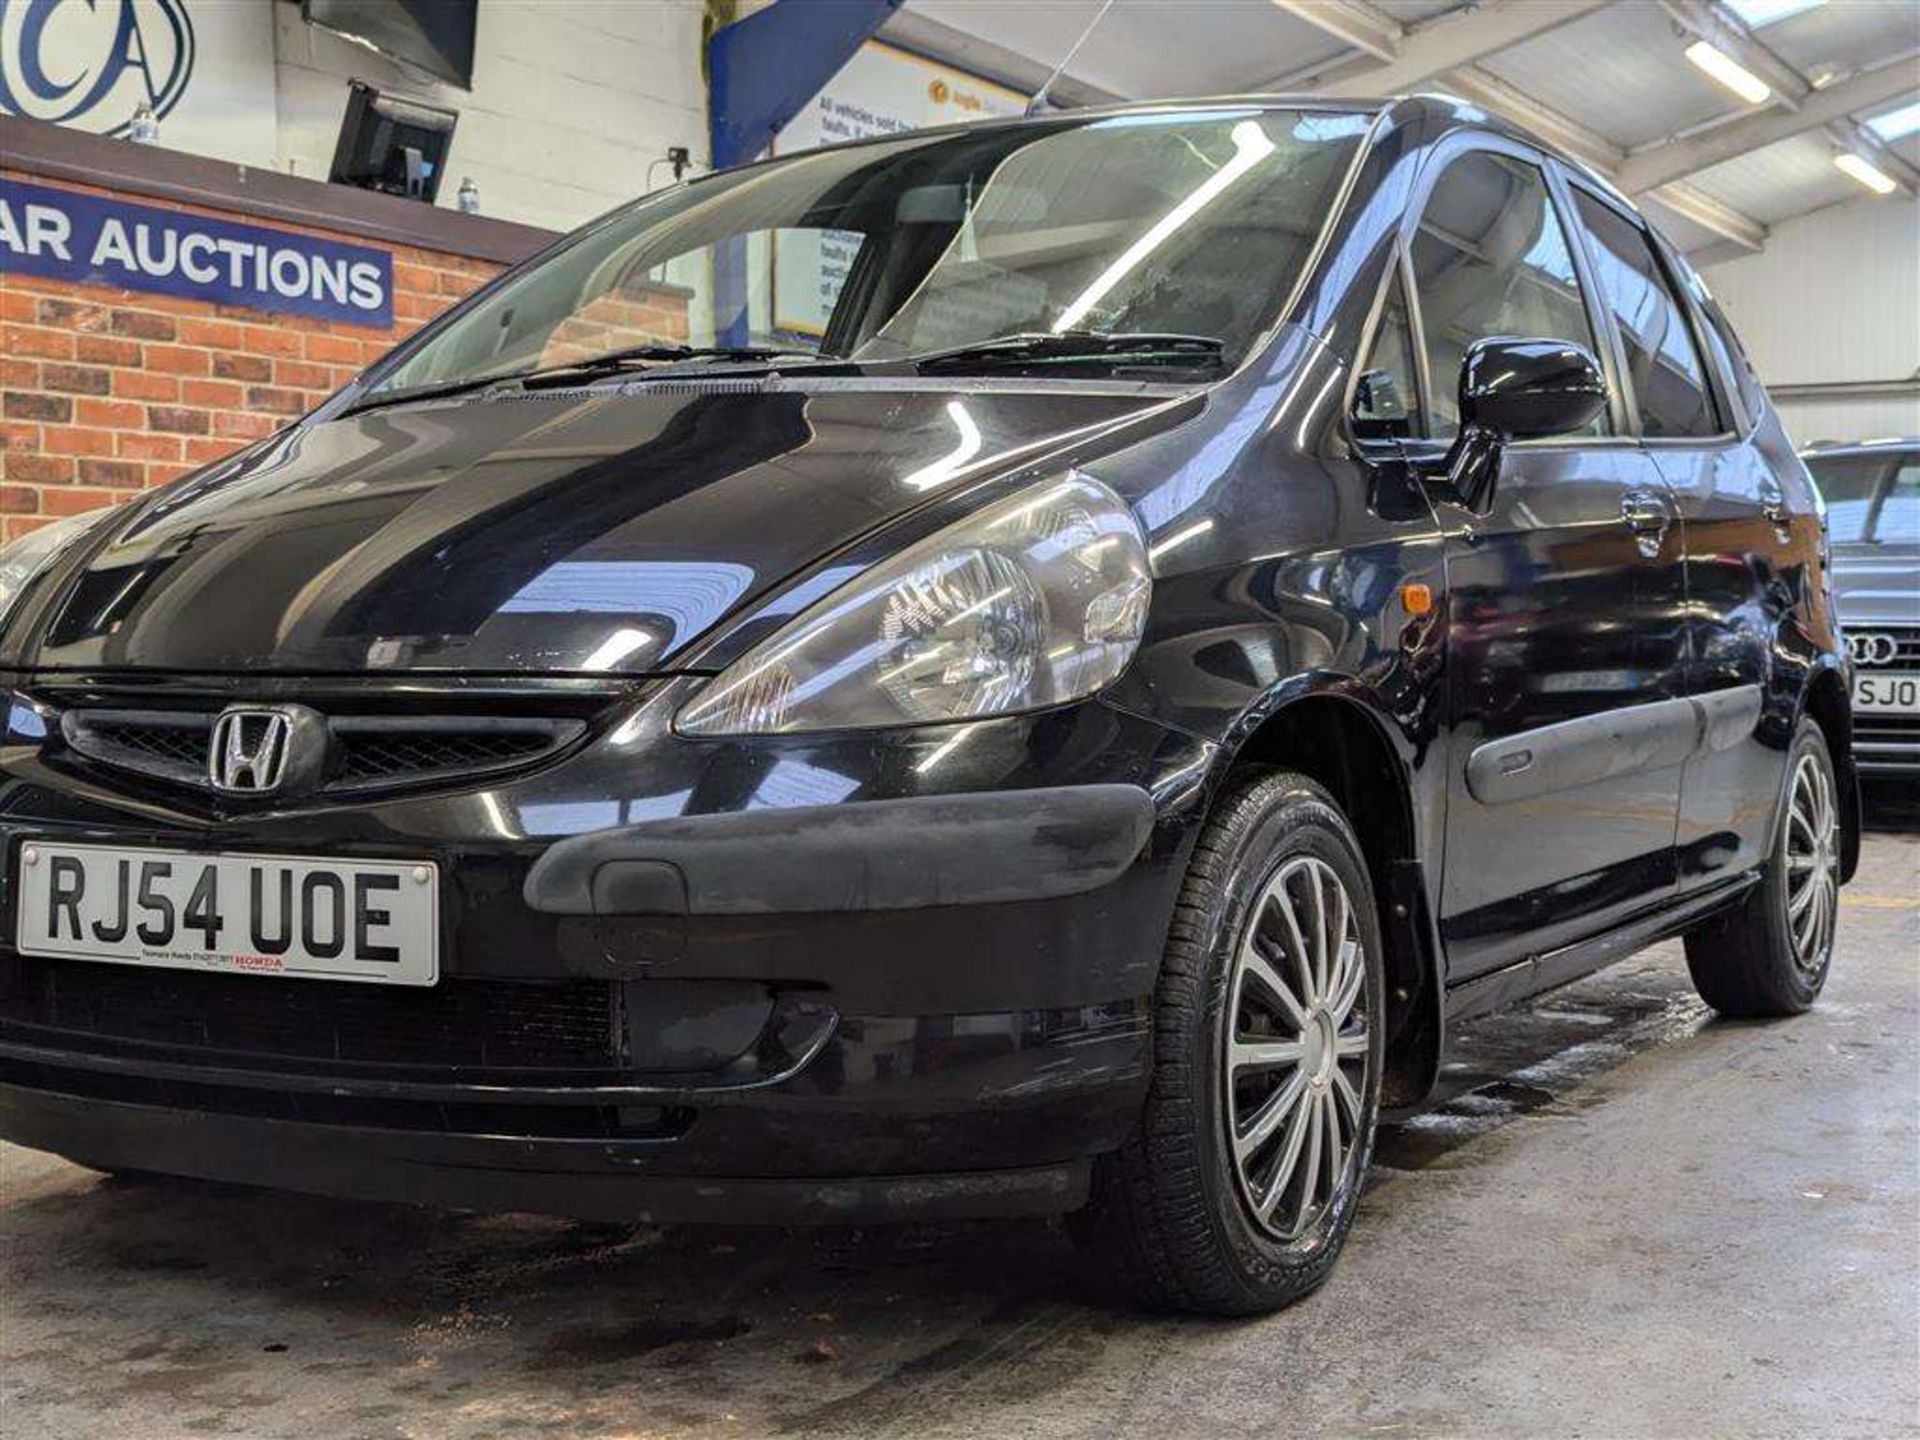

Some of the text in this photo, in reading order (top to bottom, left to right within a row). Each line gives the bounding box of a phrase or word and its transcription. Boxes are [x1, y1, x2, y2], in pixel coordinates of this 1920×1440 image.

[90, 218, 384, 310] AUCTIONS
[48, 855, 400, 962] RJ54 UOE
[235, 954, 283, 968] HONDA
